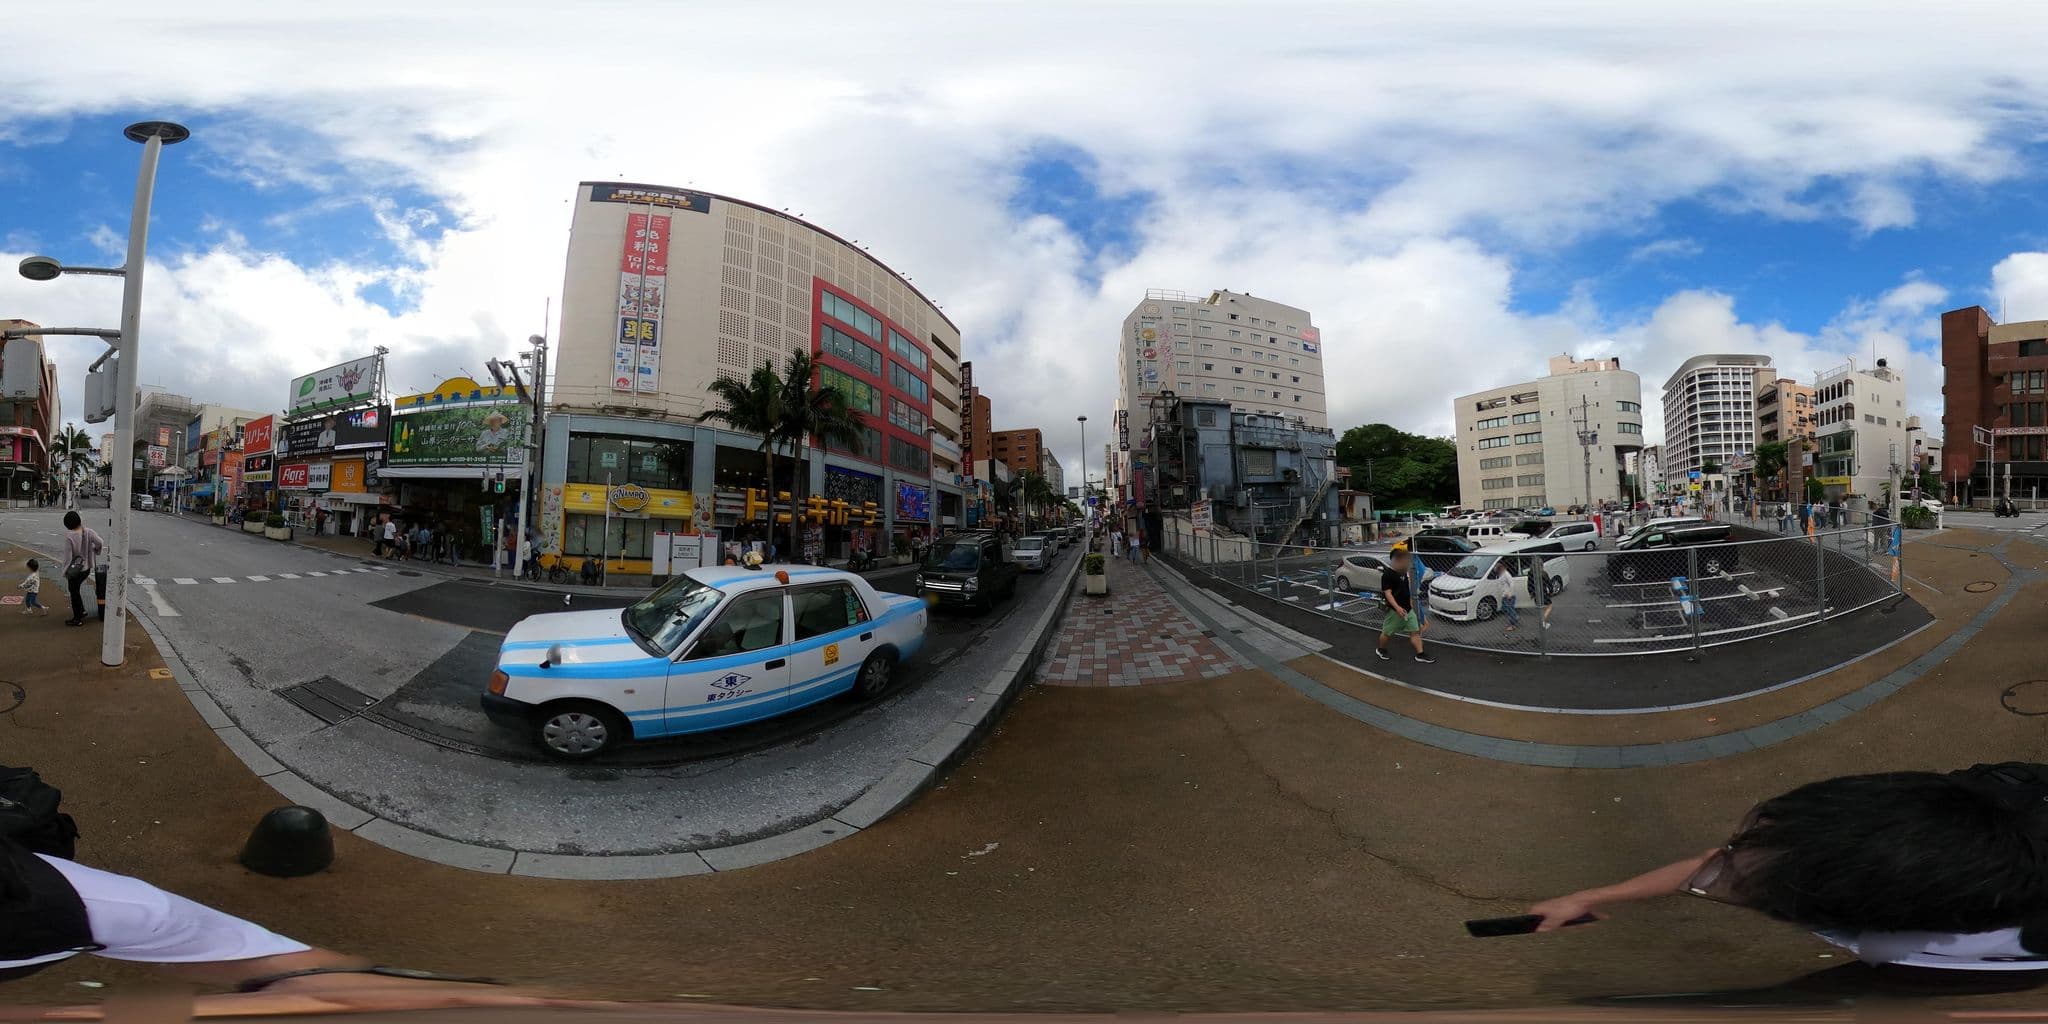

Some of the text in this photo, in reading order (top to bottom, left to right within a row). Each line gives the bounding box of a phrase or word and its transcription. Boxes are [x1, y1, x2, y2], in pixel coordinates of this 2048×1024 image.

[627, 255, 656, 264] Tax
[630, 262, 665, 272] Free
[282, 468, 306, 484] Agre
[725, 675, 738, 687] 東
[706, 689, 753, 702] 東タクシー
